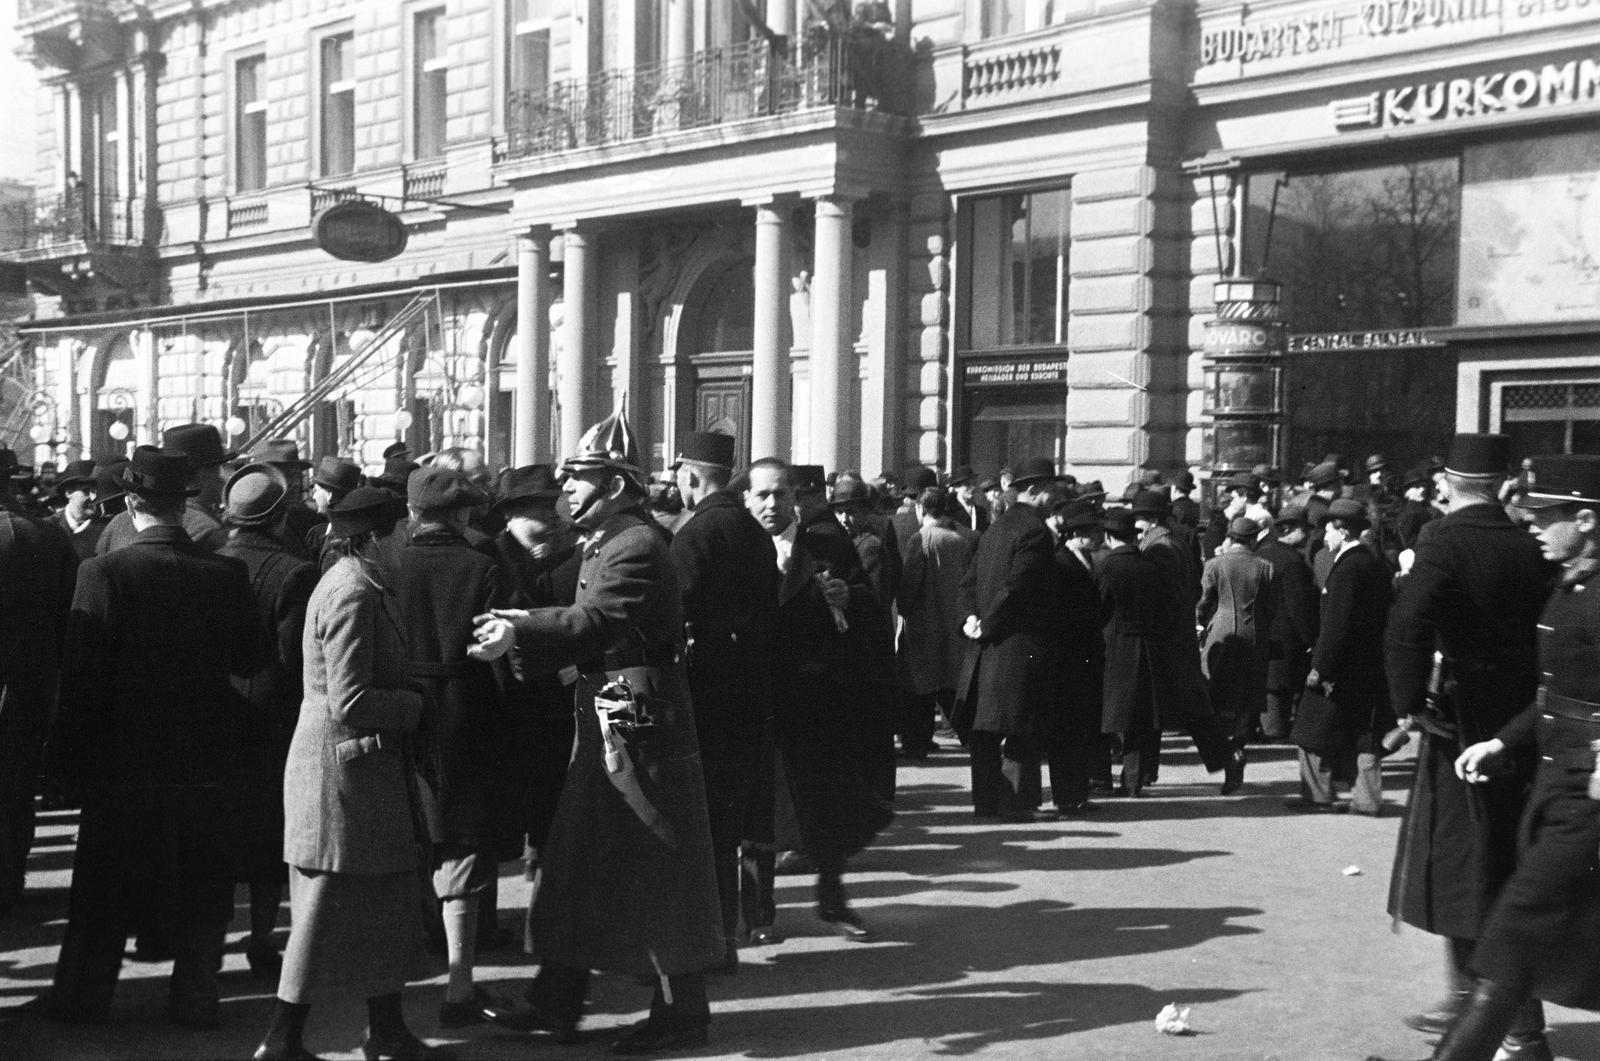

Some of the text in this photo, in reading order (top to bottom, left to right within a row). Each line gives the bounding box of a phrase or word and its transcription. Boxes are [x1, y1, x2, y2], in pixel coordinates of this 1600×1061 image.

[1383, 59, 1600, 127] KURKOMM
[1302, 334, 1356, 351] CENTRAL
[1033, 361, 1067, 372] BUDAPEST
